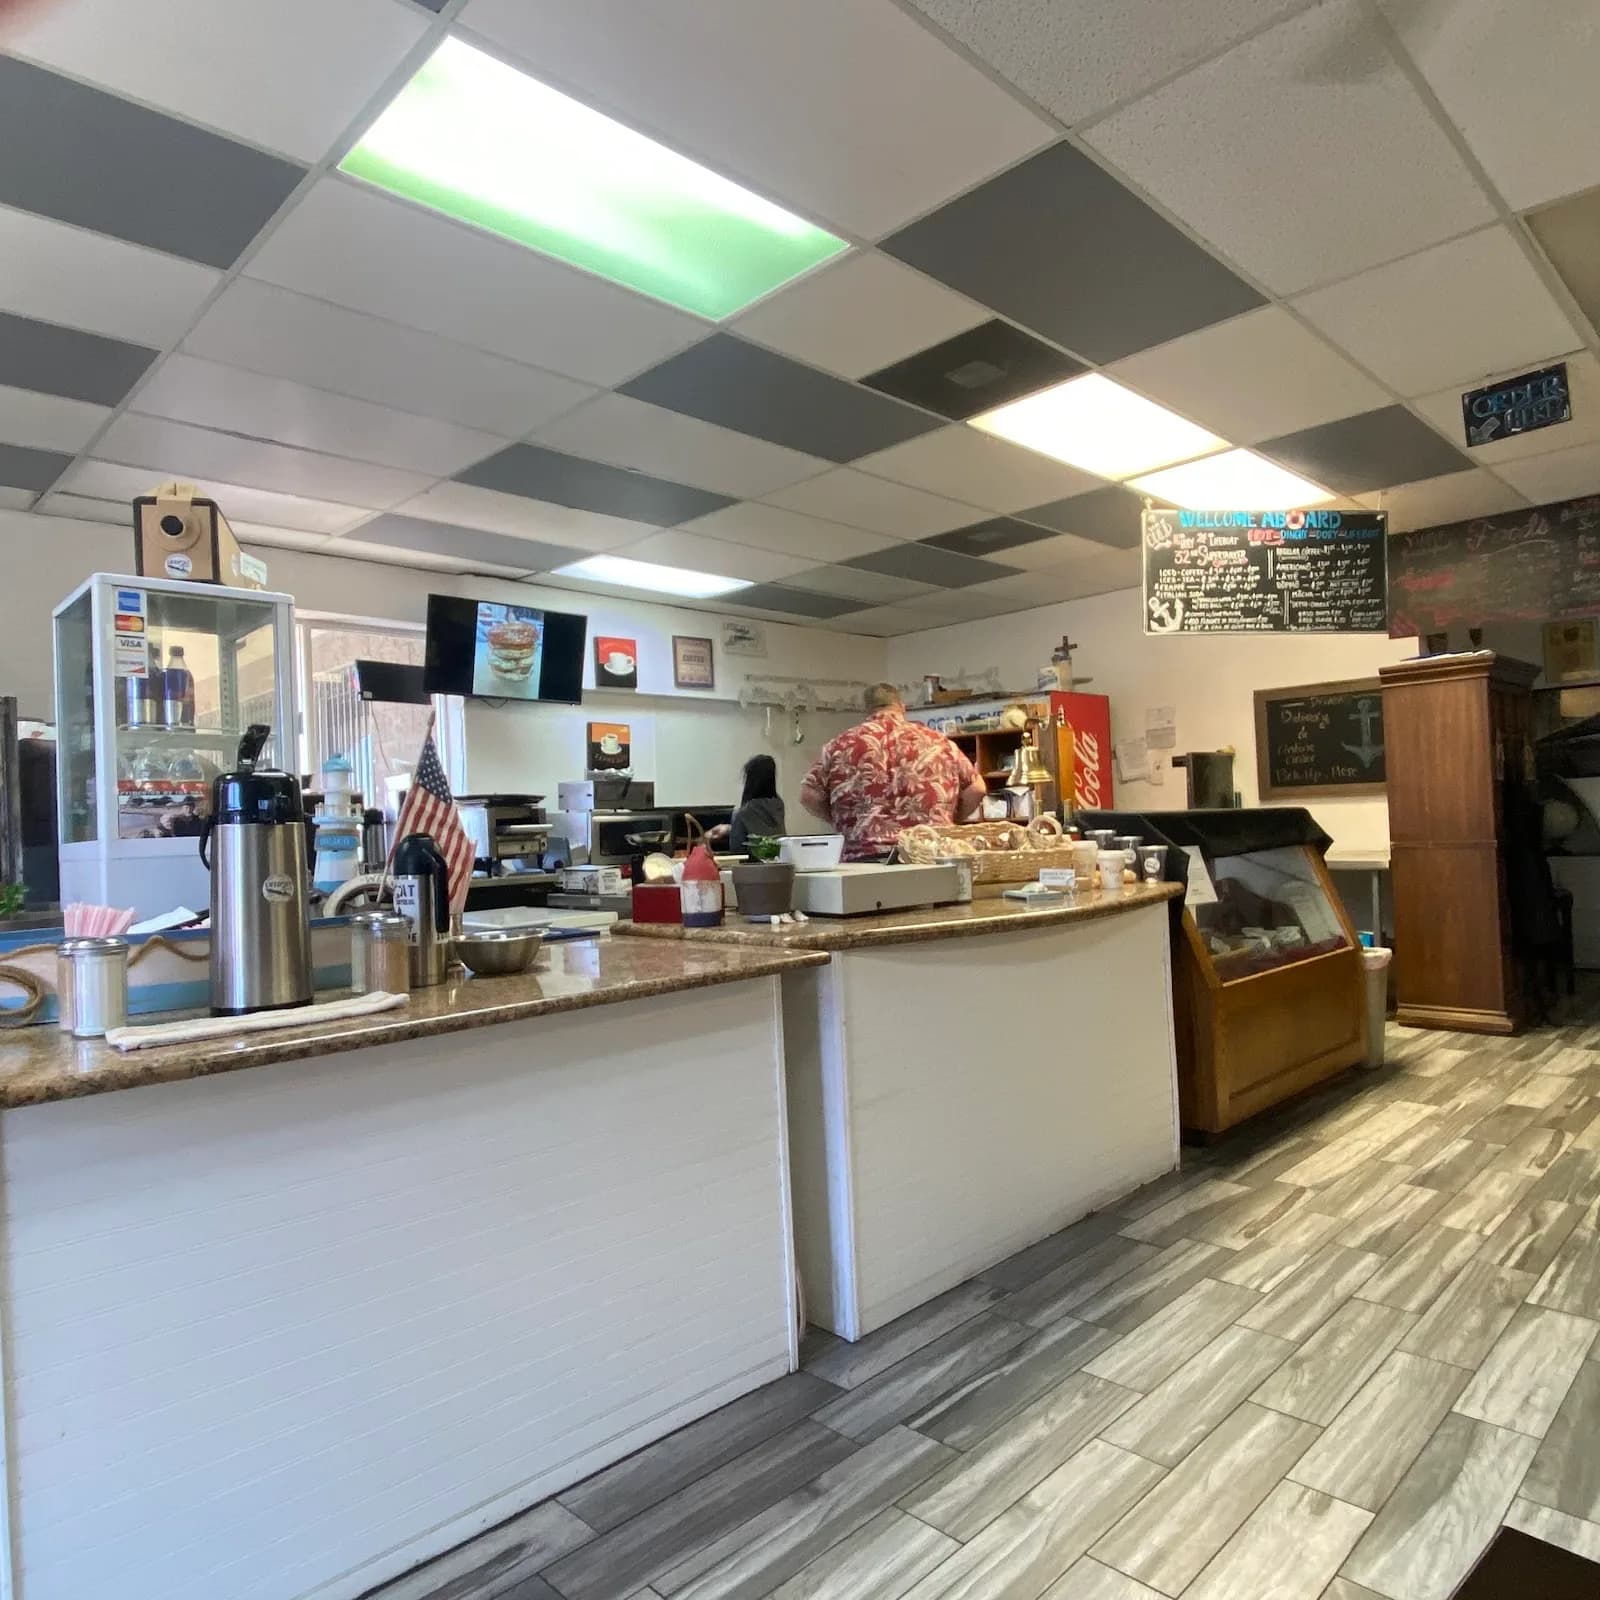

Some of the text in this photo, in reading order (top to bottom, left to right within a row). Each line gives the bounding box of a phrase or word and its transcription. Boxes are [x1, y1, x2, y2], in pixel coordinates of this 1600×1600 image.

[1178, 510, 1341, 529] WELCOME ABOARD
[120, 639, 142, 648] VISA
